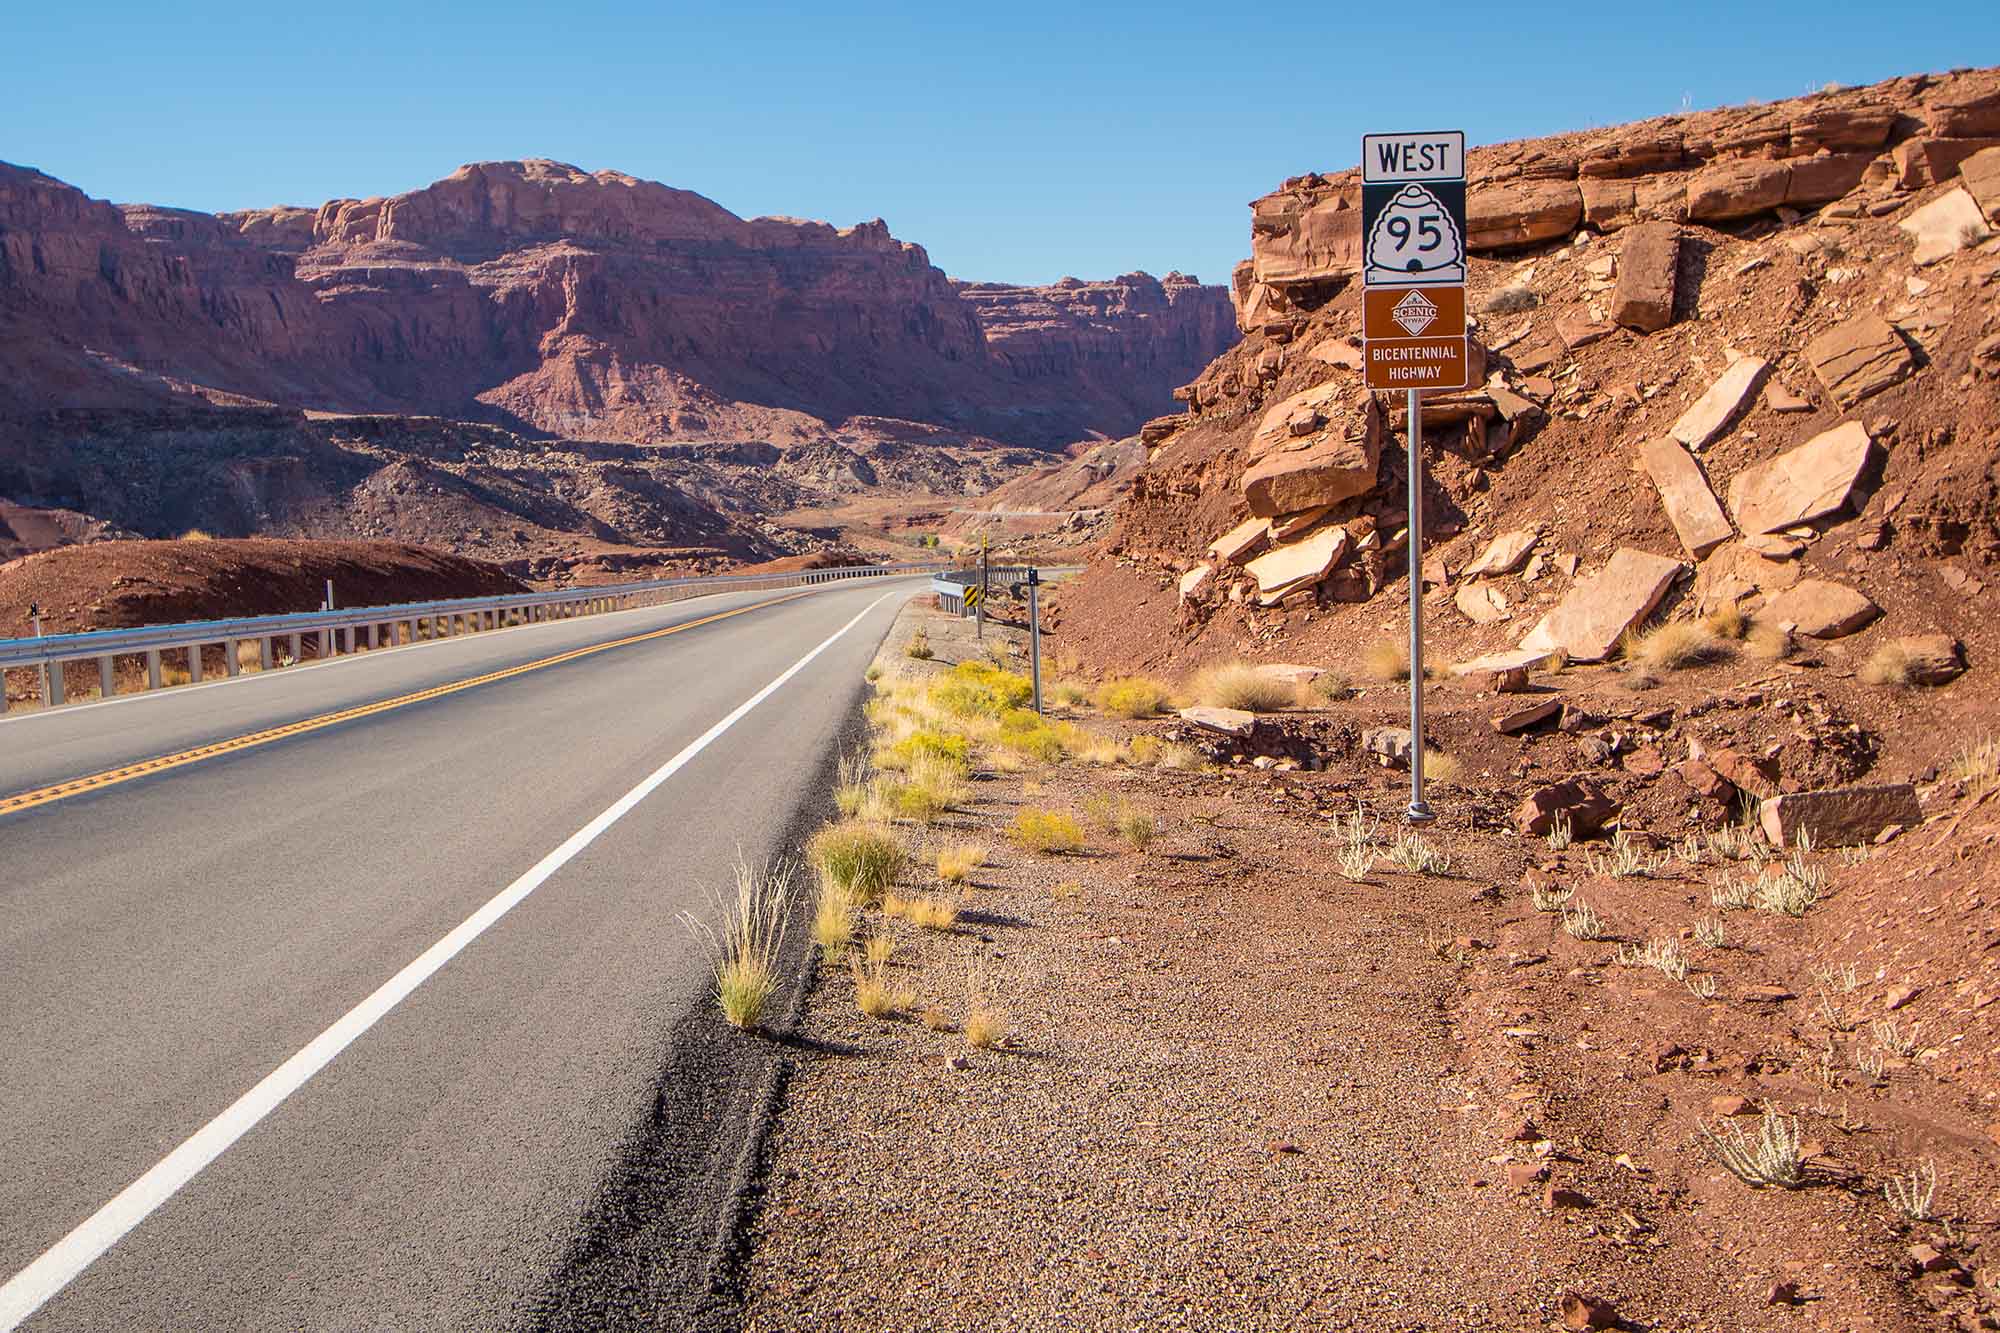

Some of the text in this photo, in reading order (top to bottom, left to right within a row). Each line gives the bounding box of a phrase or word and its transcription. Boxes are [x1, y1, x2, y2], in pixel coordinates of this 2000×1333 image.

[1377, 143, 1450, 172] WEST
[1387, 215, 1442, 252] 95
[1392, 307, 1437, 319] SCENIC
[1373, 346, 1457, 361] BICENTENNIAL
[1389, 366, 1442, 380] HIGHWAY
